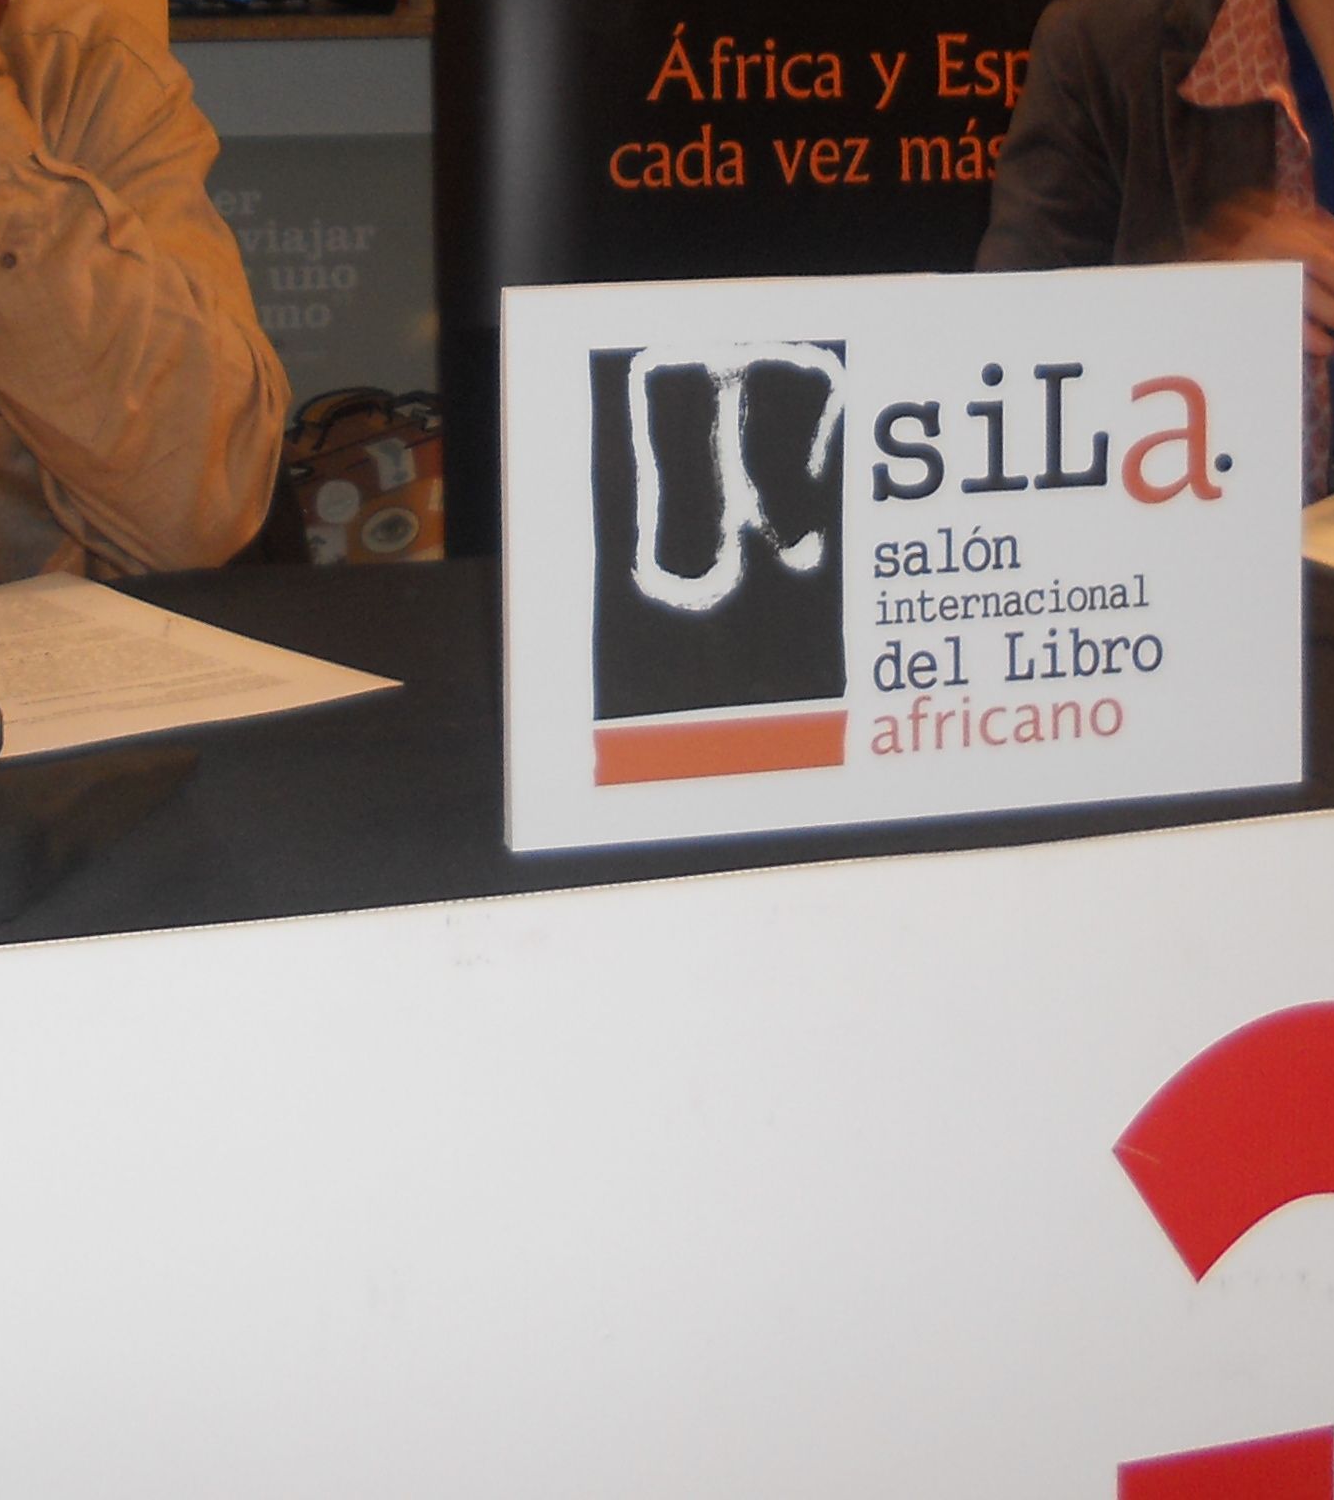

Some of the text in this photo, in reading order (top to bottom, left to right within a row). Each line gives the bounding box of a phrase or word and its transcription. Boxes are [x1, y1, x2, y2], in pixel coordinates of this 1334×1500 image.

[646, 21, 844, 102] África
[869, 49, 908, 111] y
[608, 118, 1009, 190] cada vez más
[237, 218, 377, 262] viajar
[269, 264, 359, 291] uno
[870, 360, 1234, 506] siLa.
[872, 525, 1022, 580] salón
[874, 573, 1152, 627] internacional
[871, 629, 1165, 693] del Libro
[869, 695, 1126, 758] africano
